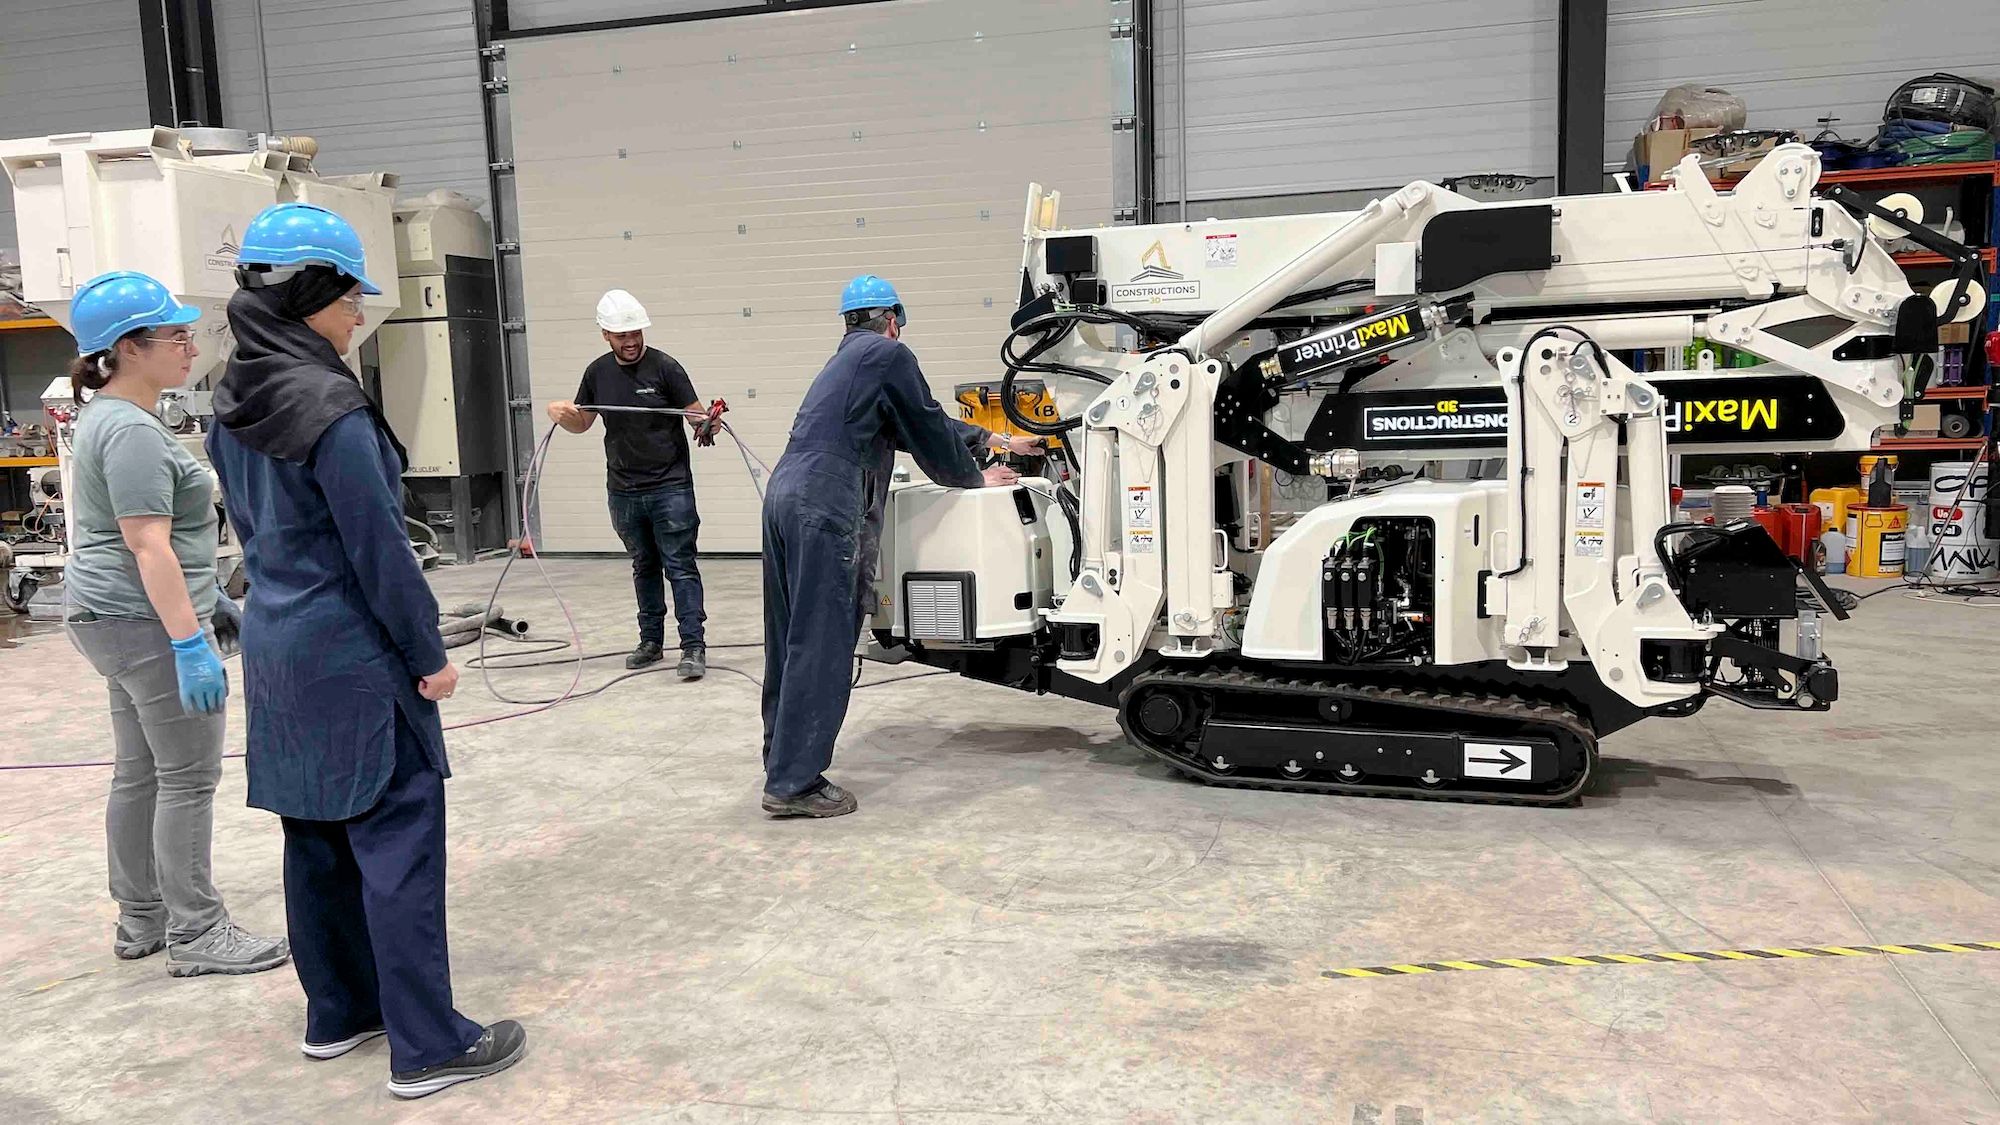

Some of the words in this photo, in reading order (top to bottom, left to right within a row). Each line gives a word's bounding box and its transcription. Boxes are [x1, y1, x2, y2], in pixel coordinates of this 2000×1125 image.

[208, 258, 236, 268] CONSTRU
[1116, 286, 1196, 297] CONSTRUCTIONS
[1294, 314, 1410, 362] MaxiPrinter
[1437, 400, 1459, 413] 3D
[1372, 413, 1508, 431] ONSTRUCTIONS
[1665, 399, 1778, 431] MaxiP
